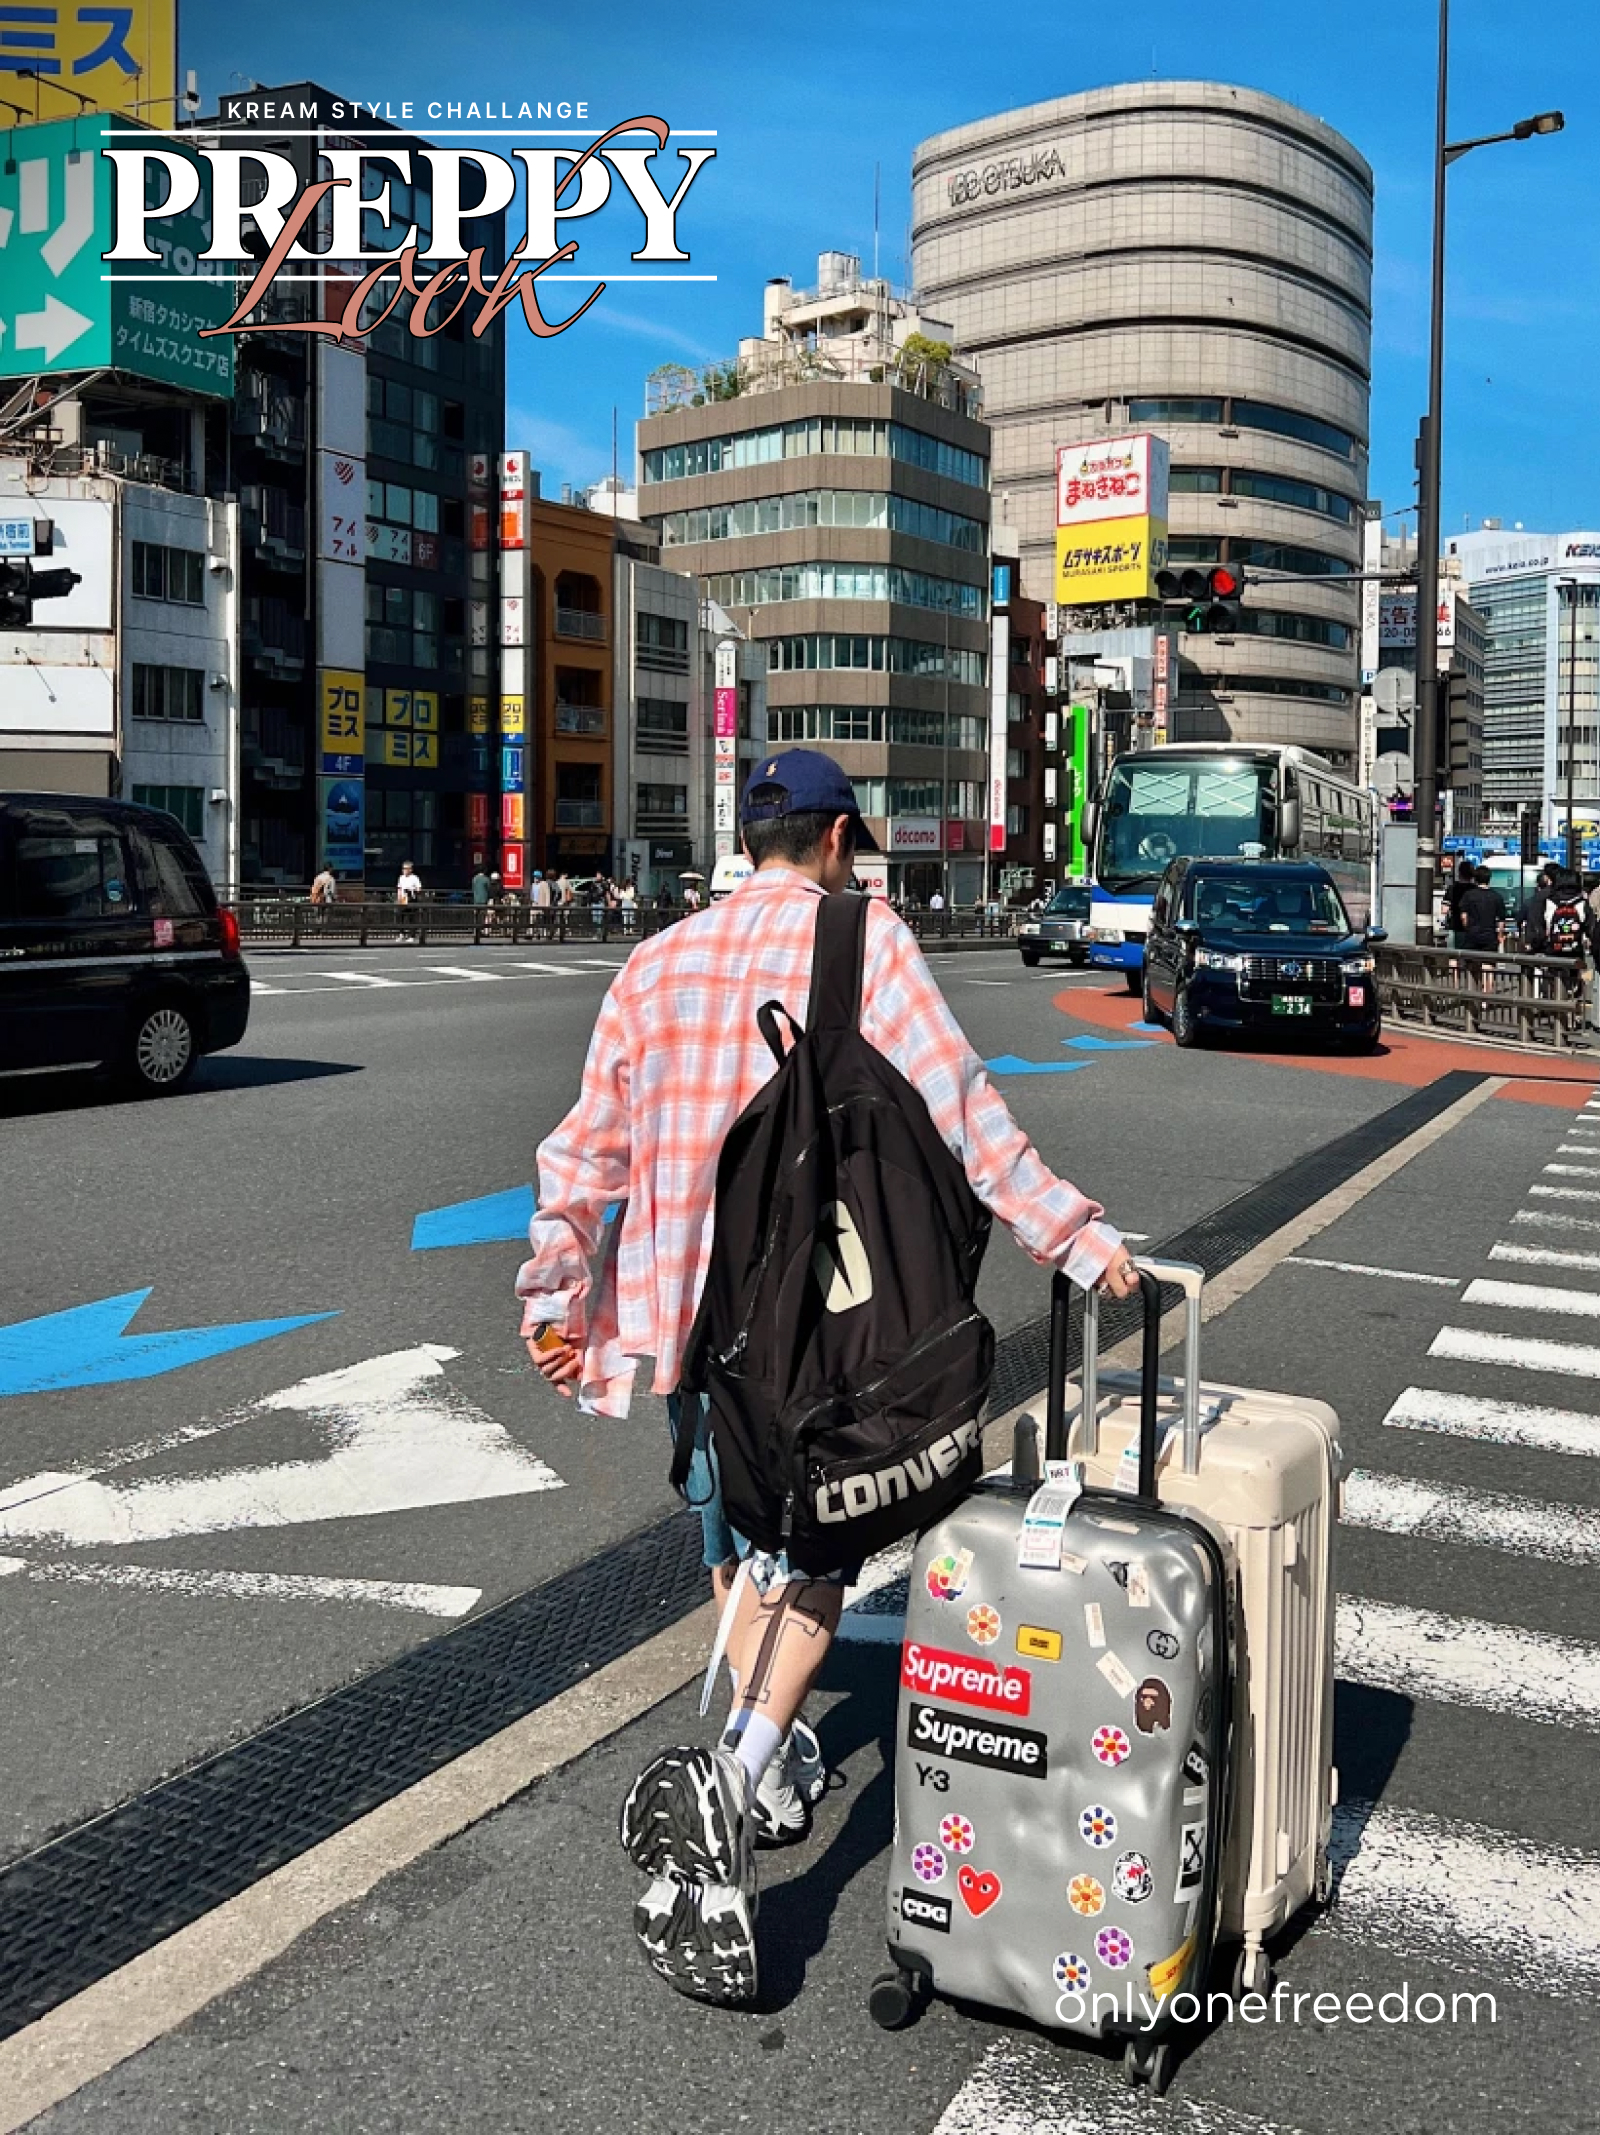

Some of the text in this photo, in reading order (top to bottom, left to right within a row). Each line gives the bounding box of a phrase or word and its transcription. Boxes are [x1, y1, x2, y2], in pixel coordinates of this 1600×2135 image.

[981, 147, 1066, 196] OTSUKA
[116, 324, 230, 378] タイムズスクエア店
[1065, 472, 1142, 508] まねきねこ
[327, 686, 360, 712] プロ
[327, 714, 360, 738] ミス
[894, 825, 937, 844] docomo
[904, 1645, 1023, 1702] Supreme
[913, 1707, 1041, 1764] Supreme
[915, 1762, 950, 1792] Y-3
